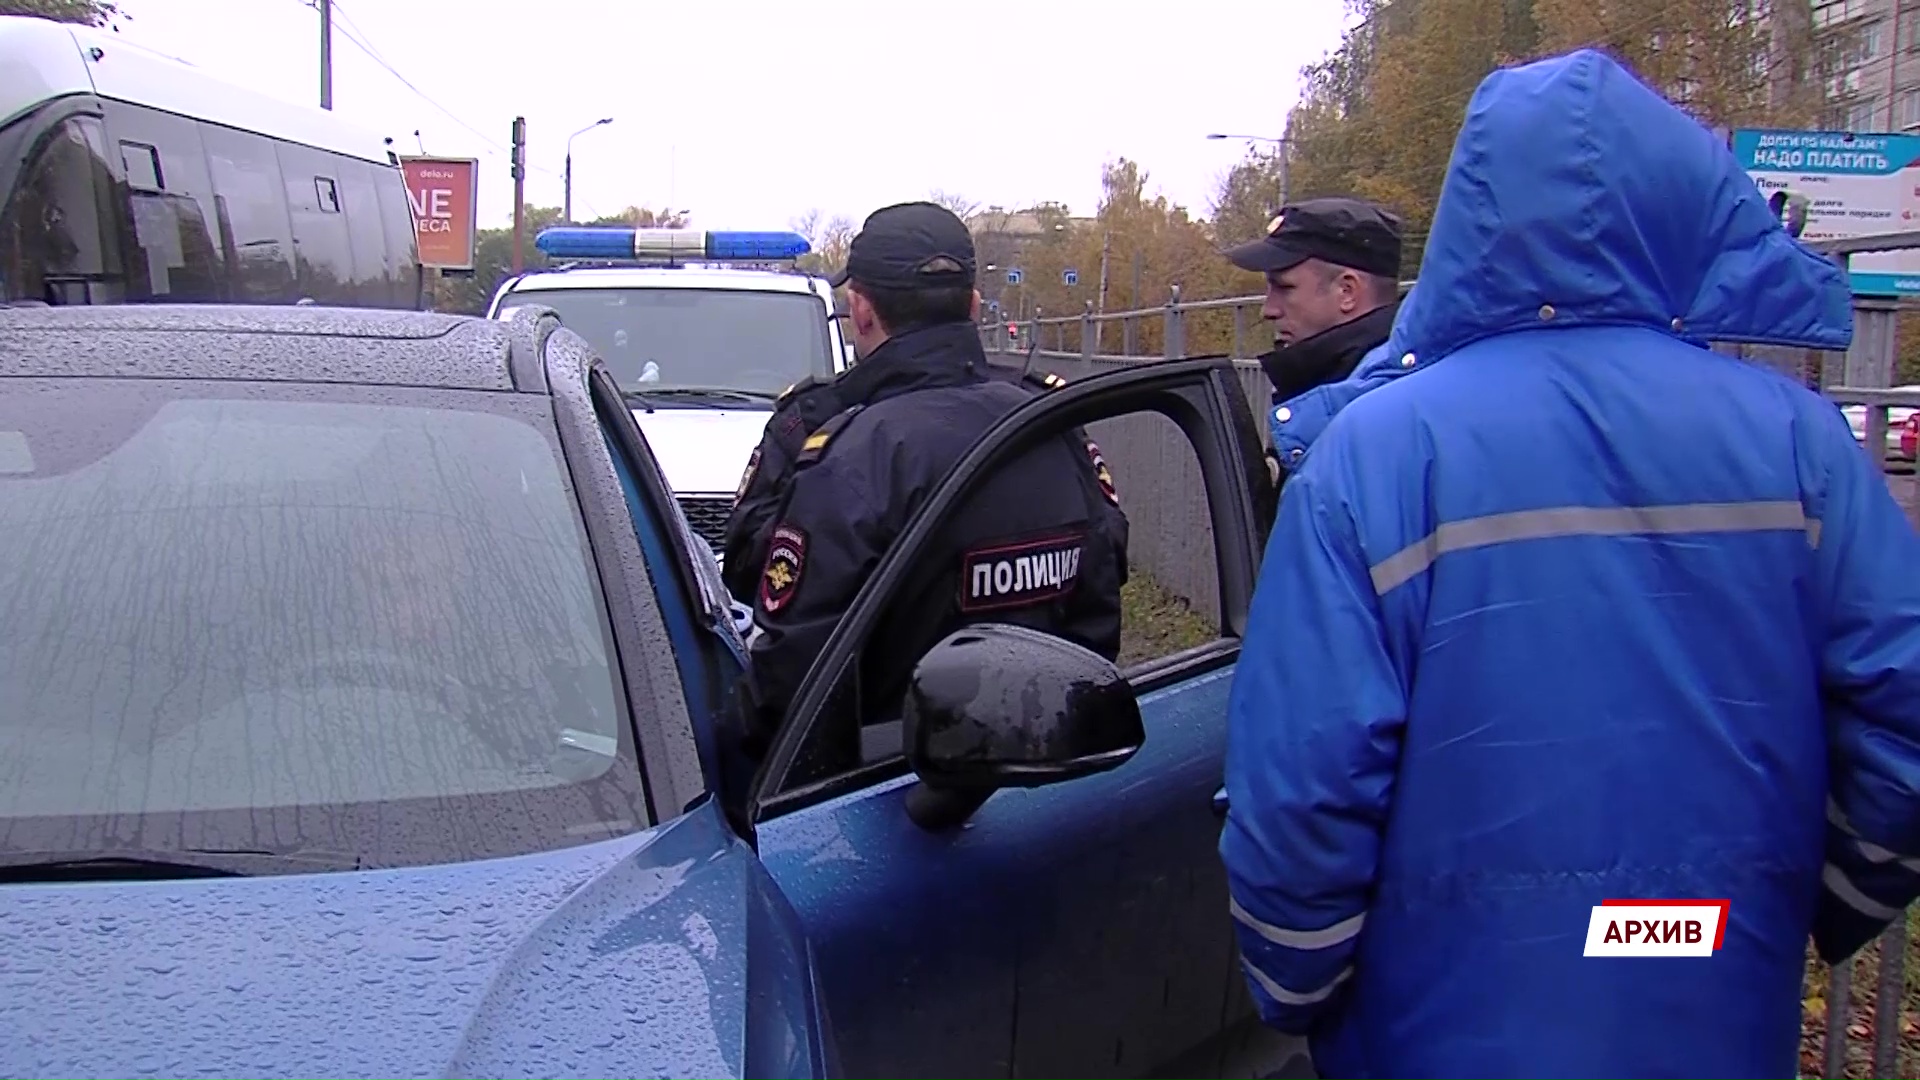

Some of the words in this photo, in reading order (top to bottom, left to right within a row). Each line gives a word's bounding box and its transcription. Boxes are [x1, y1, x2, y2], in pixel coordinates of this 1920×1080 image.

[1754, 150, 1803, 168] НАДО
[1807, 151, 1889, 169] ПЛАТИТЬ
[420, 170, 454, 178] delo.ru
[971, 546, 1081, 598] ПОЛИЦИЯ
